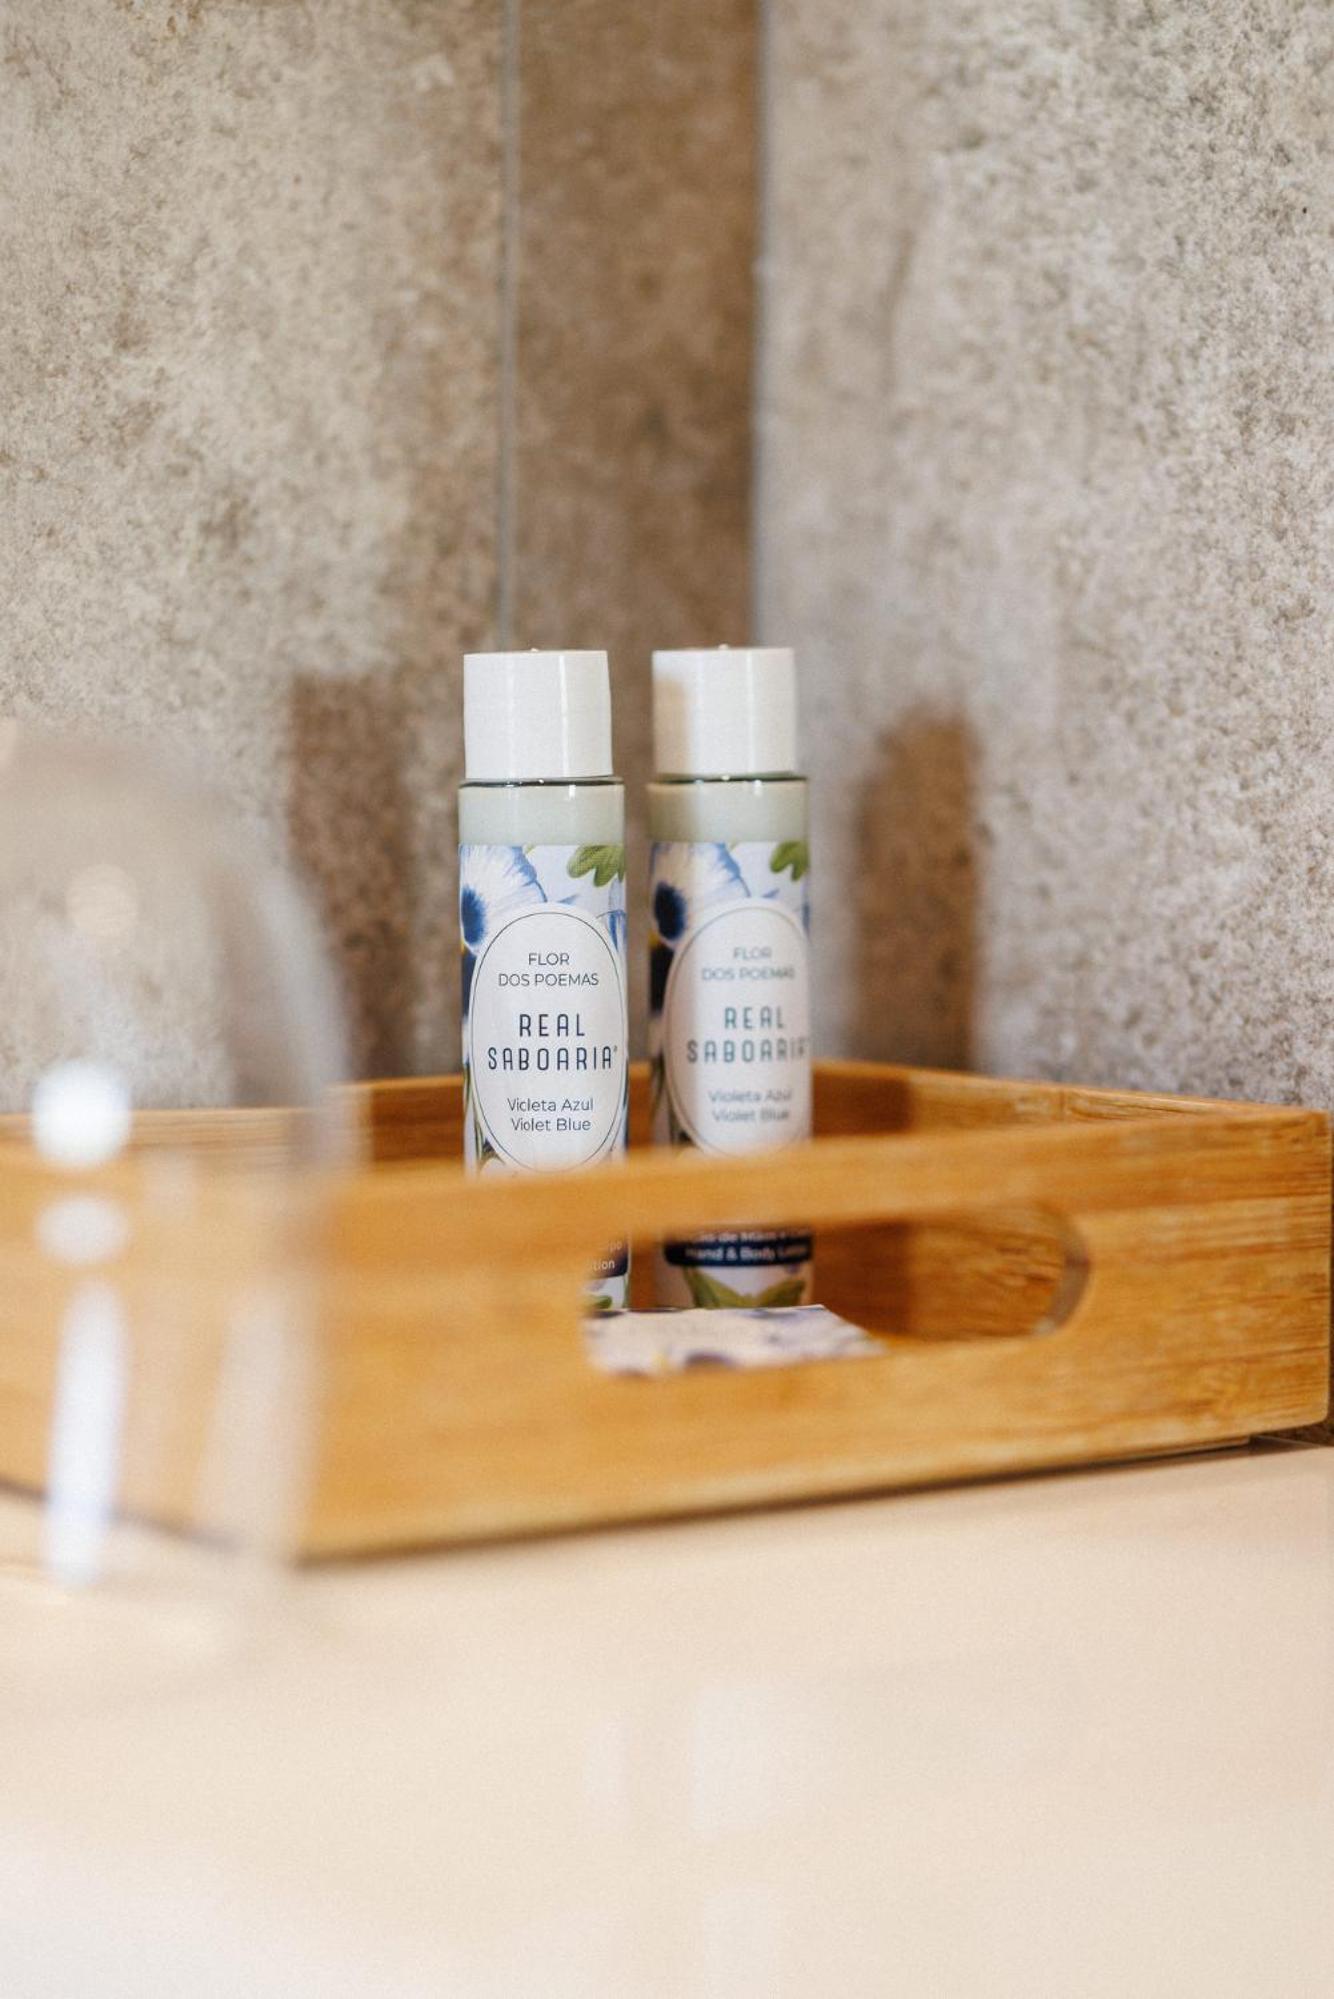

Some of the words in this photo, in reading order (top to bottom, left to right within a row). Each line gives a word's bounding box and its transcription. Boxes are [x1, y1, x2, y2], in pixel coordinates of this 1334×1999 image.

[528, 952, 570, 966] FLOR
[733, 946, 772, 960] FLOR
[498, 973, 530, 987] DOS
[534, 972, 599, 987] POEMAS
[702, 967, 735, 981] DOS
[739, 966, 795, 980] POEMAS
[519, 1013, 585, 1037] REAL
[724, 1006, 784, 1029] REAL
[560, 1097, 594, 1112] Azul
[510, 1117, 552, 1131] Violet
[556, 1116, 592, 1131] Blue
